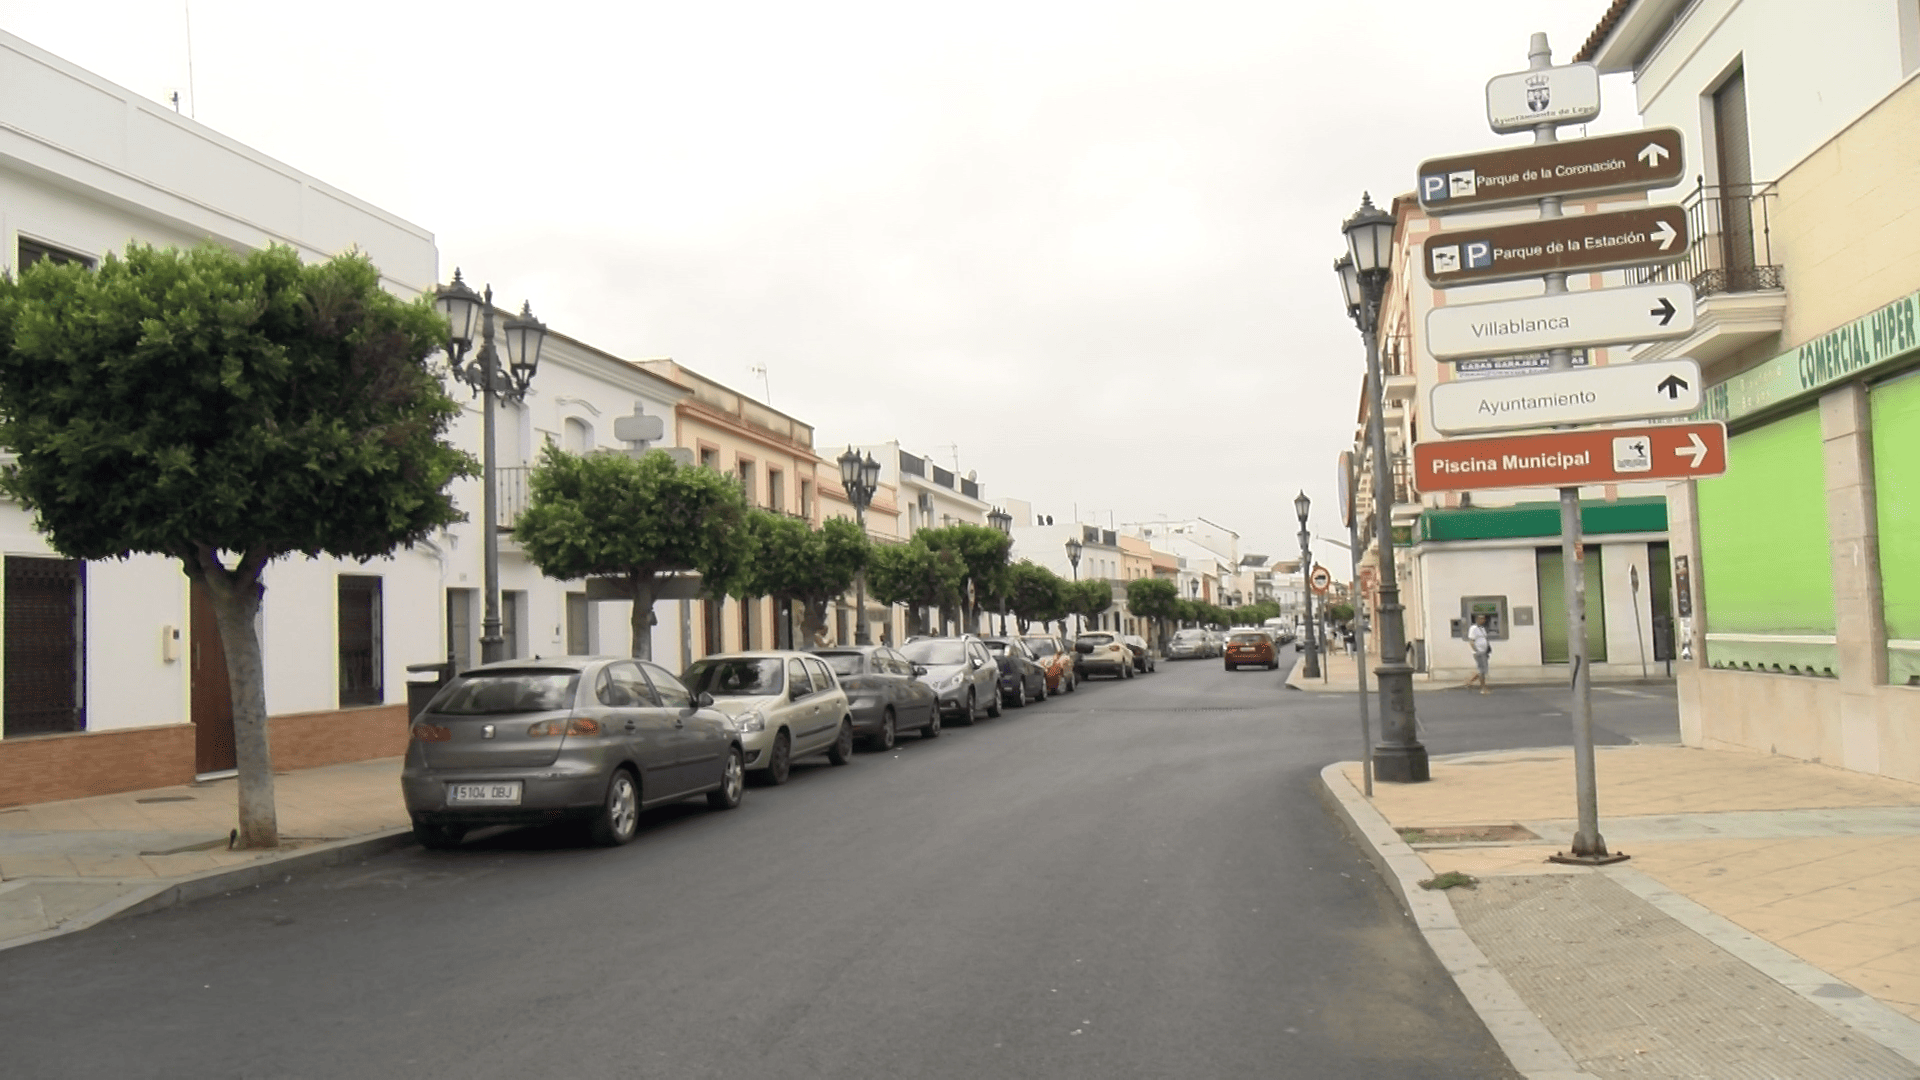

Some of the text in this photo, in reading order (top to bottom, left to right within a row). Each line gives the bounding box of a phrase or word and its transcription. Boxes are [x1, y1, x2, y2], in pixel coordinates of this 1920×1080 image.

[1476, 172, 1520, 187] Parque
[1522, 169, 1538, 181] de
[1540, 167, 1552, 179] la
[1555, 157, 1626, 177] Coronación
[1493, 245, 1543, 261] Parque
[1546, 241, 1564, 254] de
[1567, 239, 1581, 251] la
[1584, 231, 1646, 249] Estación
[1471, 315, 1570, 339] Villablanca
[1798, 320, 1871, 390] COMERCIAL
[1872, 297, 1916, 361] HIPER
[1477, 390, 1597, 415] Ayuntamiento
[1432, 450, 1591, 475] Piscina Municipal
[460, 785, 513, 798] 5104 DBJ
